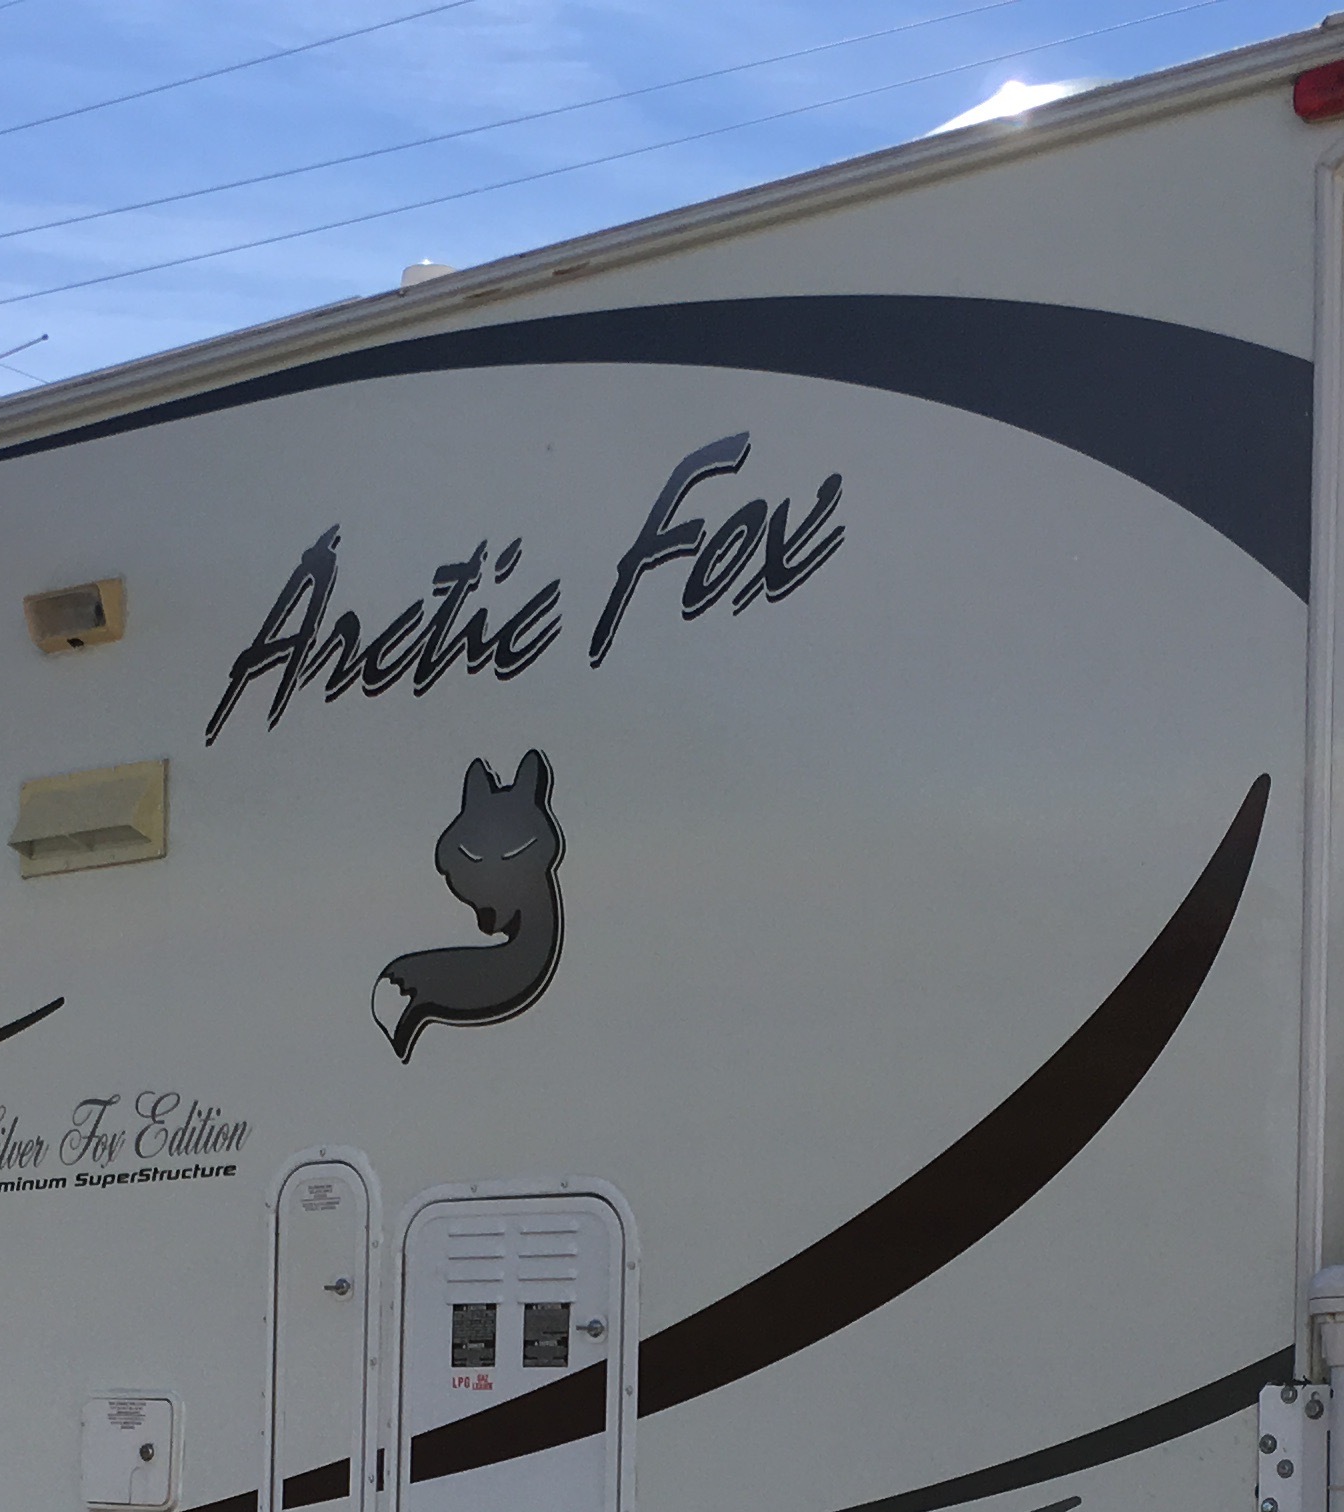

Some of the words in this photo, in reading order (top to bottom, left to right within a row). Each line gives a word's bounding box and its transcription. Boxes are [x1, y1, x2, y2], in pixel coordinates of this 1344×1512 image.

[205, 523, 562, 748] Arctic
[589, 431, 846, 669] Fox
[59, 1094, 125, 1169] Fox
[133, 1090, 252, 1159] Edition
[74, 1163, 237, 1189] SuperStructure
